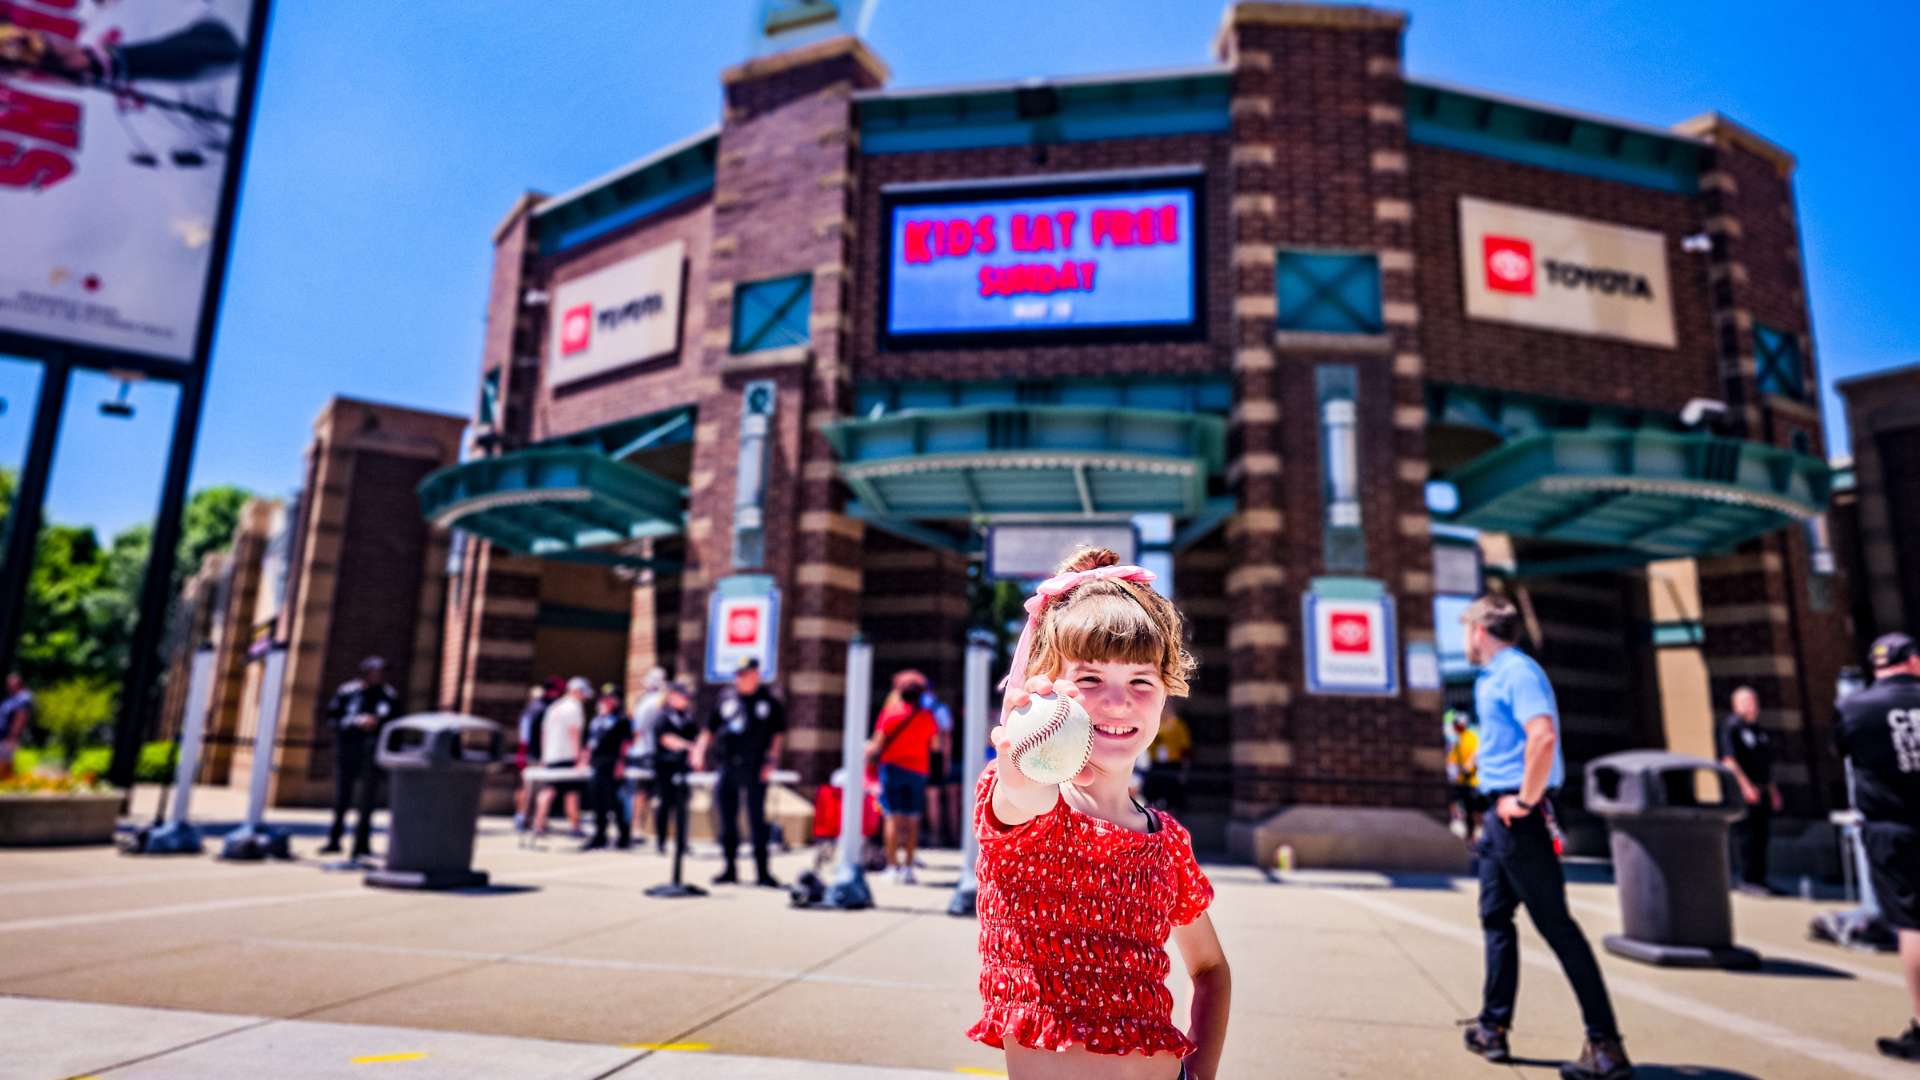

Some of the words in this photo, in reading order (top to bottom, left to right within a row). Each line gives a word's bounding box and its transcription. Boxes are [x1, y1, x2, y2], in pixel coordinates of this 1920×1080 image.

[905, 216, 996, 263] KIDS
[1092, 204, 1177, 247] FREE
[979, 261, 1096, 297] SUNDAY
[1543, 258, 1654, 300] TOYOTA
